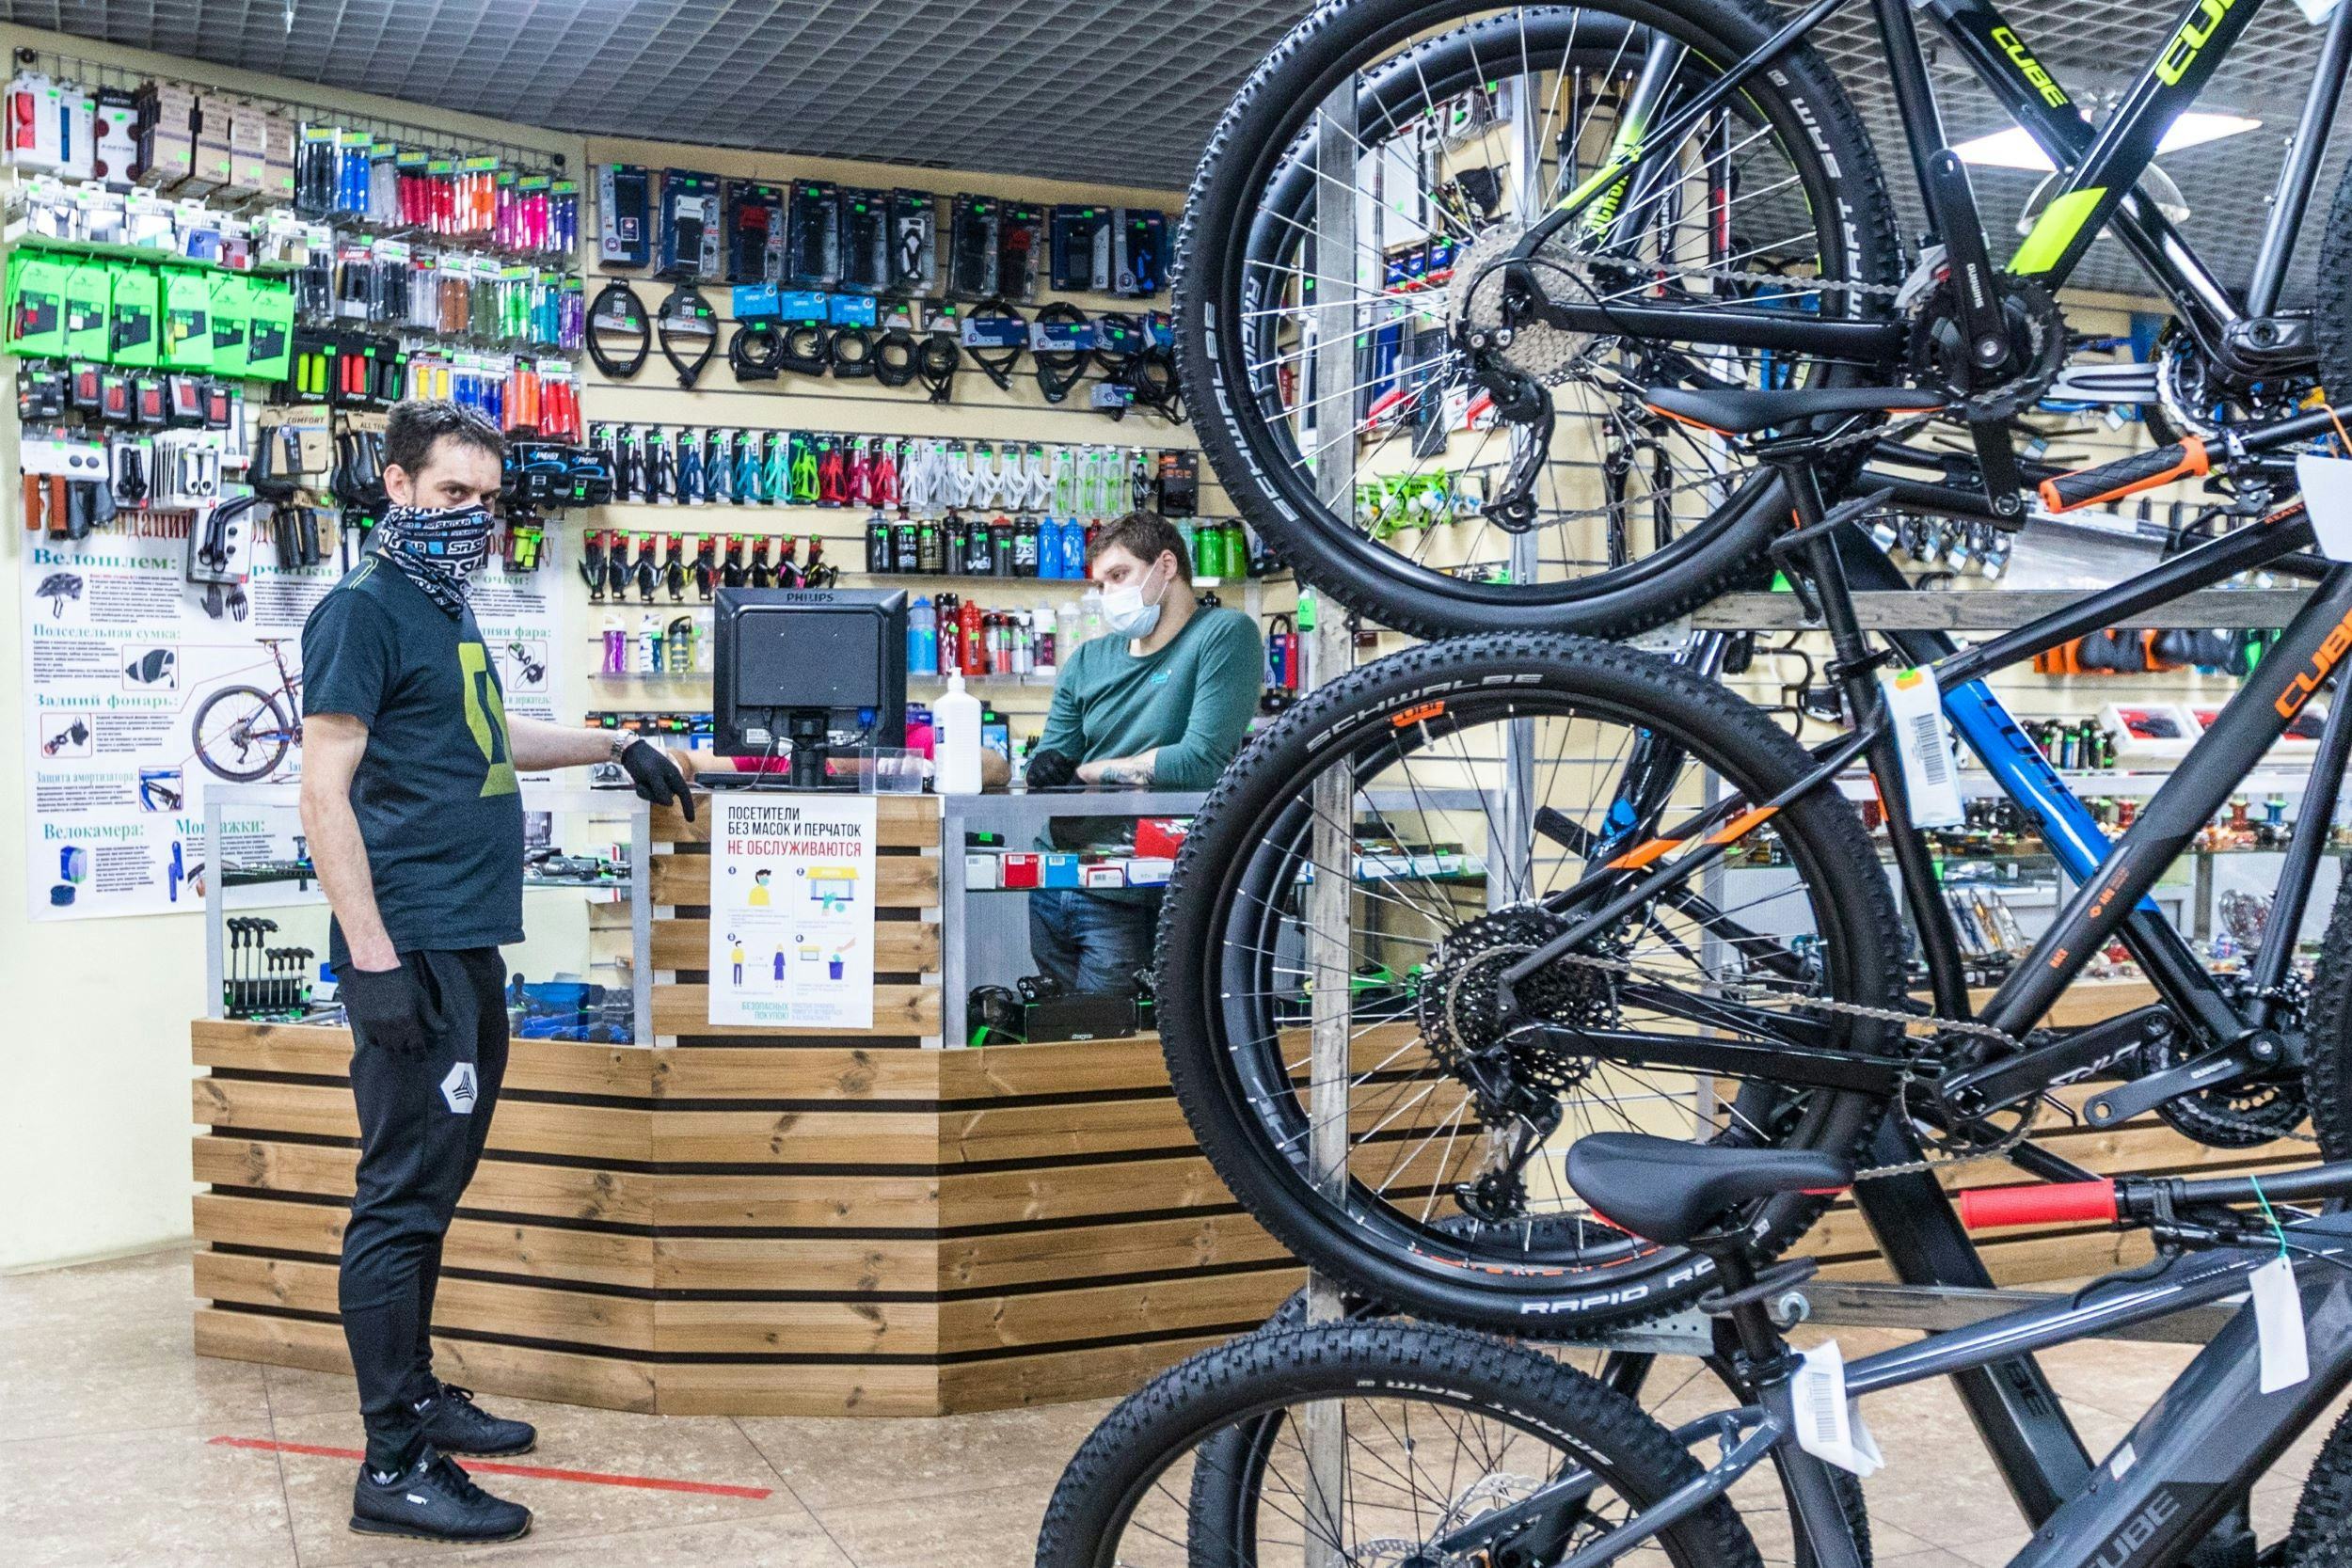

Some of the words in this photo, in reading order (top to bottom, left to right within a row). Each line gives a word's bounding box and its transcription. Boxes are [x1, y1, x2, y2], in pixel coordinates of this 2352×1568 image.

[2155, 0, 2237, 87] CU
[1990, 26, 2068, 109] CUBE
[1203, 302, 1299, 522] SCHWALBE
[33, 548, 179, 570] Велошлем:
[787, 593, 834, 603] PHILIPS
[33, 624, 132, 639] Подседельная
[135, 627, 181, 640] сумка:
[515, 626, 552, 641] фара:
[2275, 607, 2352, 718] CUB
[34, 692, 101, 706] Задний
[105, 694, 179, 709] фонарь:
[1306, 673, 1544, 753] SCHWALBE
[37, 770, 71, 784] Защита
[728, 806, 800, 820] ПОСЕТИТЕЛИ
[43, 822, 145, 841] Велокамера:
[728, 823, 750, 835] БЕЗ
[752, 823, 791, 836] МАСОК
[794, 824, 802, 836] И
[804, 824, 862, 837] ПЕРЧАТОК
[728, 840, 744, 855] НЕ
[747, 841, 862, 857] ОБСЛУЖИВАЮТСЯ
[741, 1001, 788, 1011] БЕЗОПАСНЫХ
[1520, 1285, 1650, 1316] RAPID
[1666, 1255, 1714, 1289] RO
